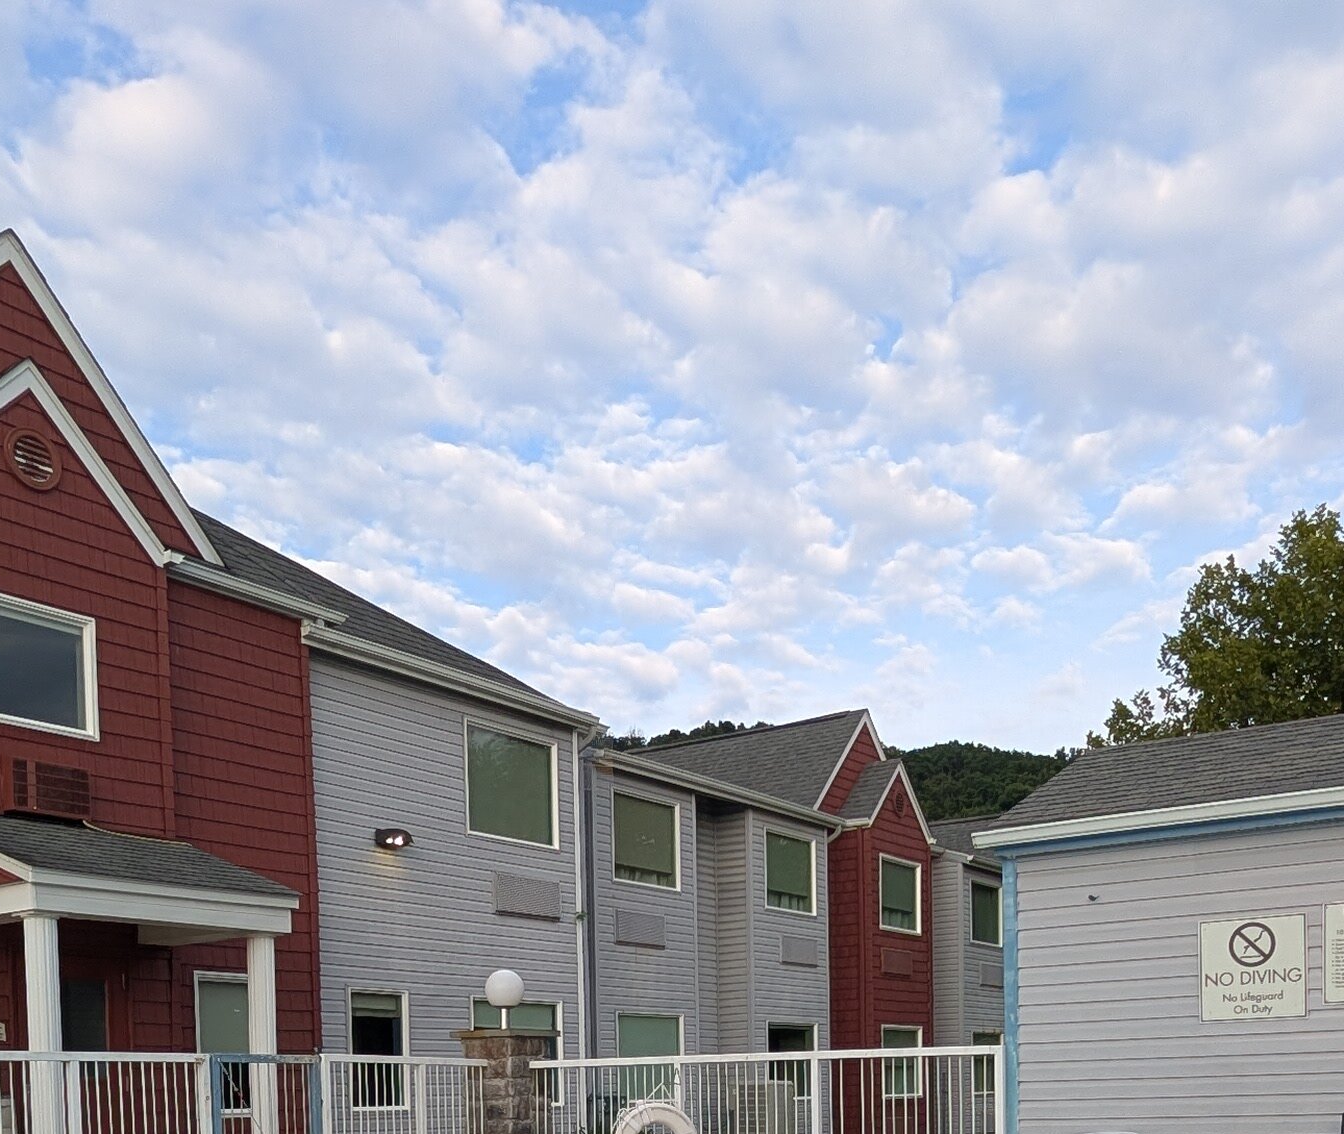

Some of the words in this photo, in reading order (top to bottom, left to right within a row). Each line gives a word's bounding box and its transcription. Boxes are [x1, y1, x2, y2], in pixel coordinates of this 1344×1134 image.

[1205, 972, 1234, 987] NO
[1240, 967, 1302, 985] DIVING
[1222, 993, 1238, 1003] No
[1240, 990, 1284, 1003] Lifeguard
[1233, 1005, 1249, 1015] On
[1251, 1004, 1273, 1015] Duty
